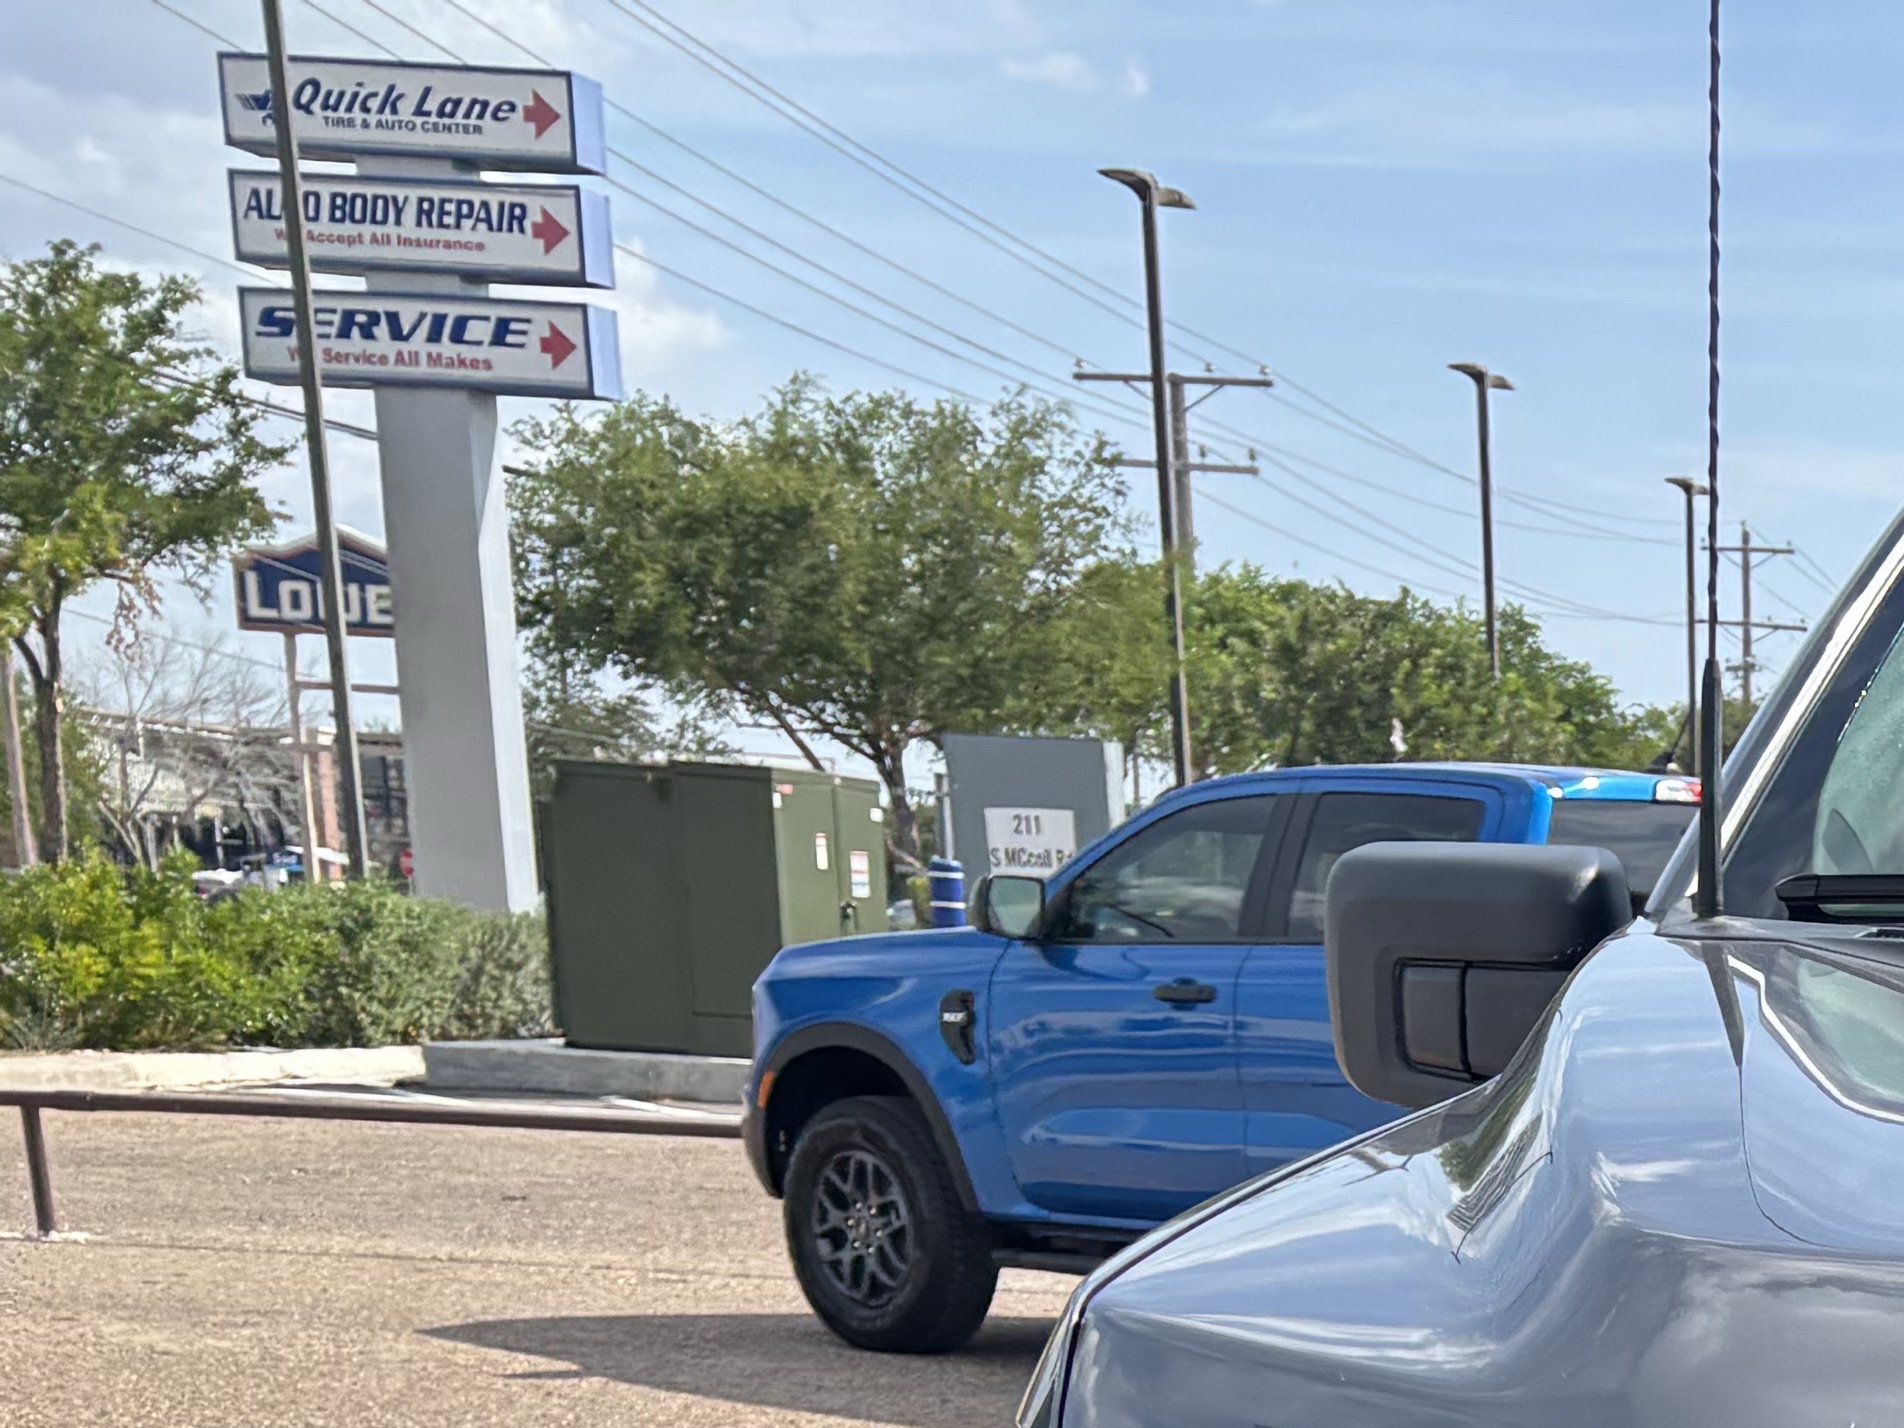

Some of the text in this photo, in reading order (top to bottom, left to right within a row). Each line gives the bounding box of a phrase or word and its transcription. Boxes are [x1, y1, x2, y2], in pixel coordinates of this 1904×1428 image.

[292, 77, 517, 122] Quick Lane
[322, 115, 483, 135] TIRE & AUTO CENTER
[328, 191, 409, 226] BODY
[415, 195, 527, 233] REPAIR
[306, 230, 364, 248] Accept
[369, 232, 392, 247] All
[397, 232, 486, 252] Insurance
[255, 306, 533, 348] SERVICE
[322, 347, 390, 367] Service
[394, 348, 420, 368] All
[427, 350, 493, 371] Makes
[1013, 814, 1042, 835] 211
[990, 847, 1001, 867] S
